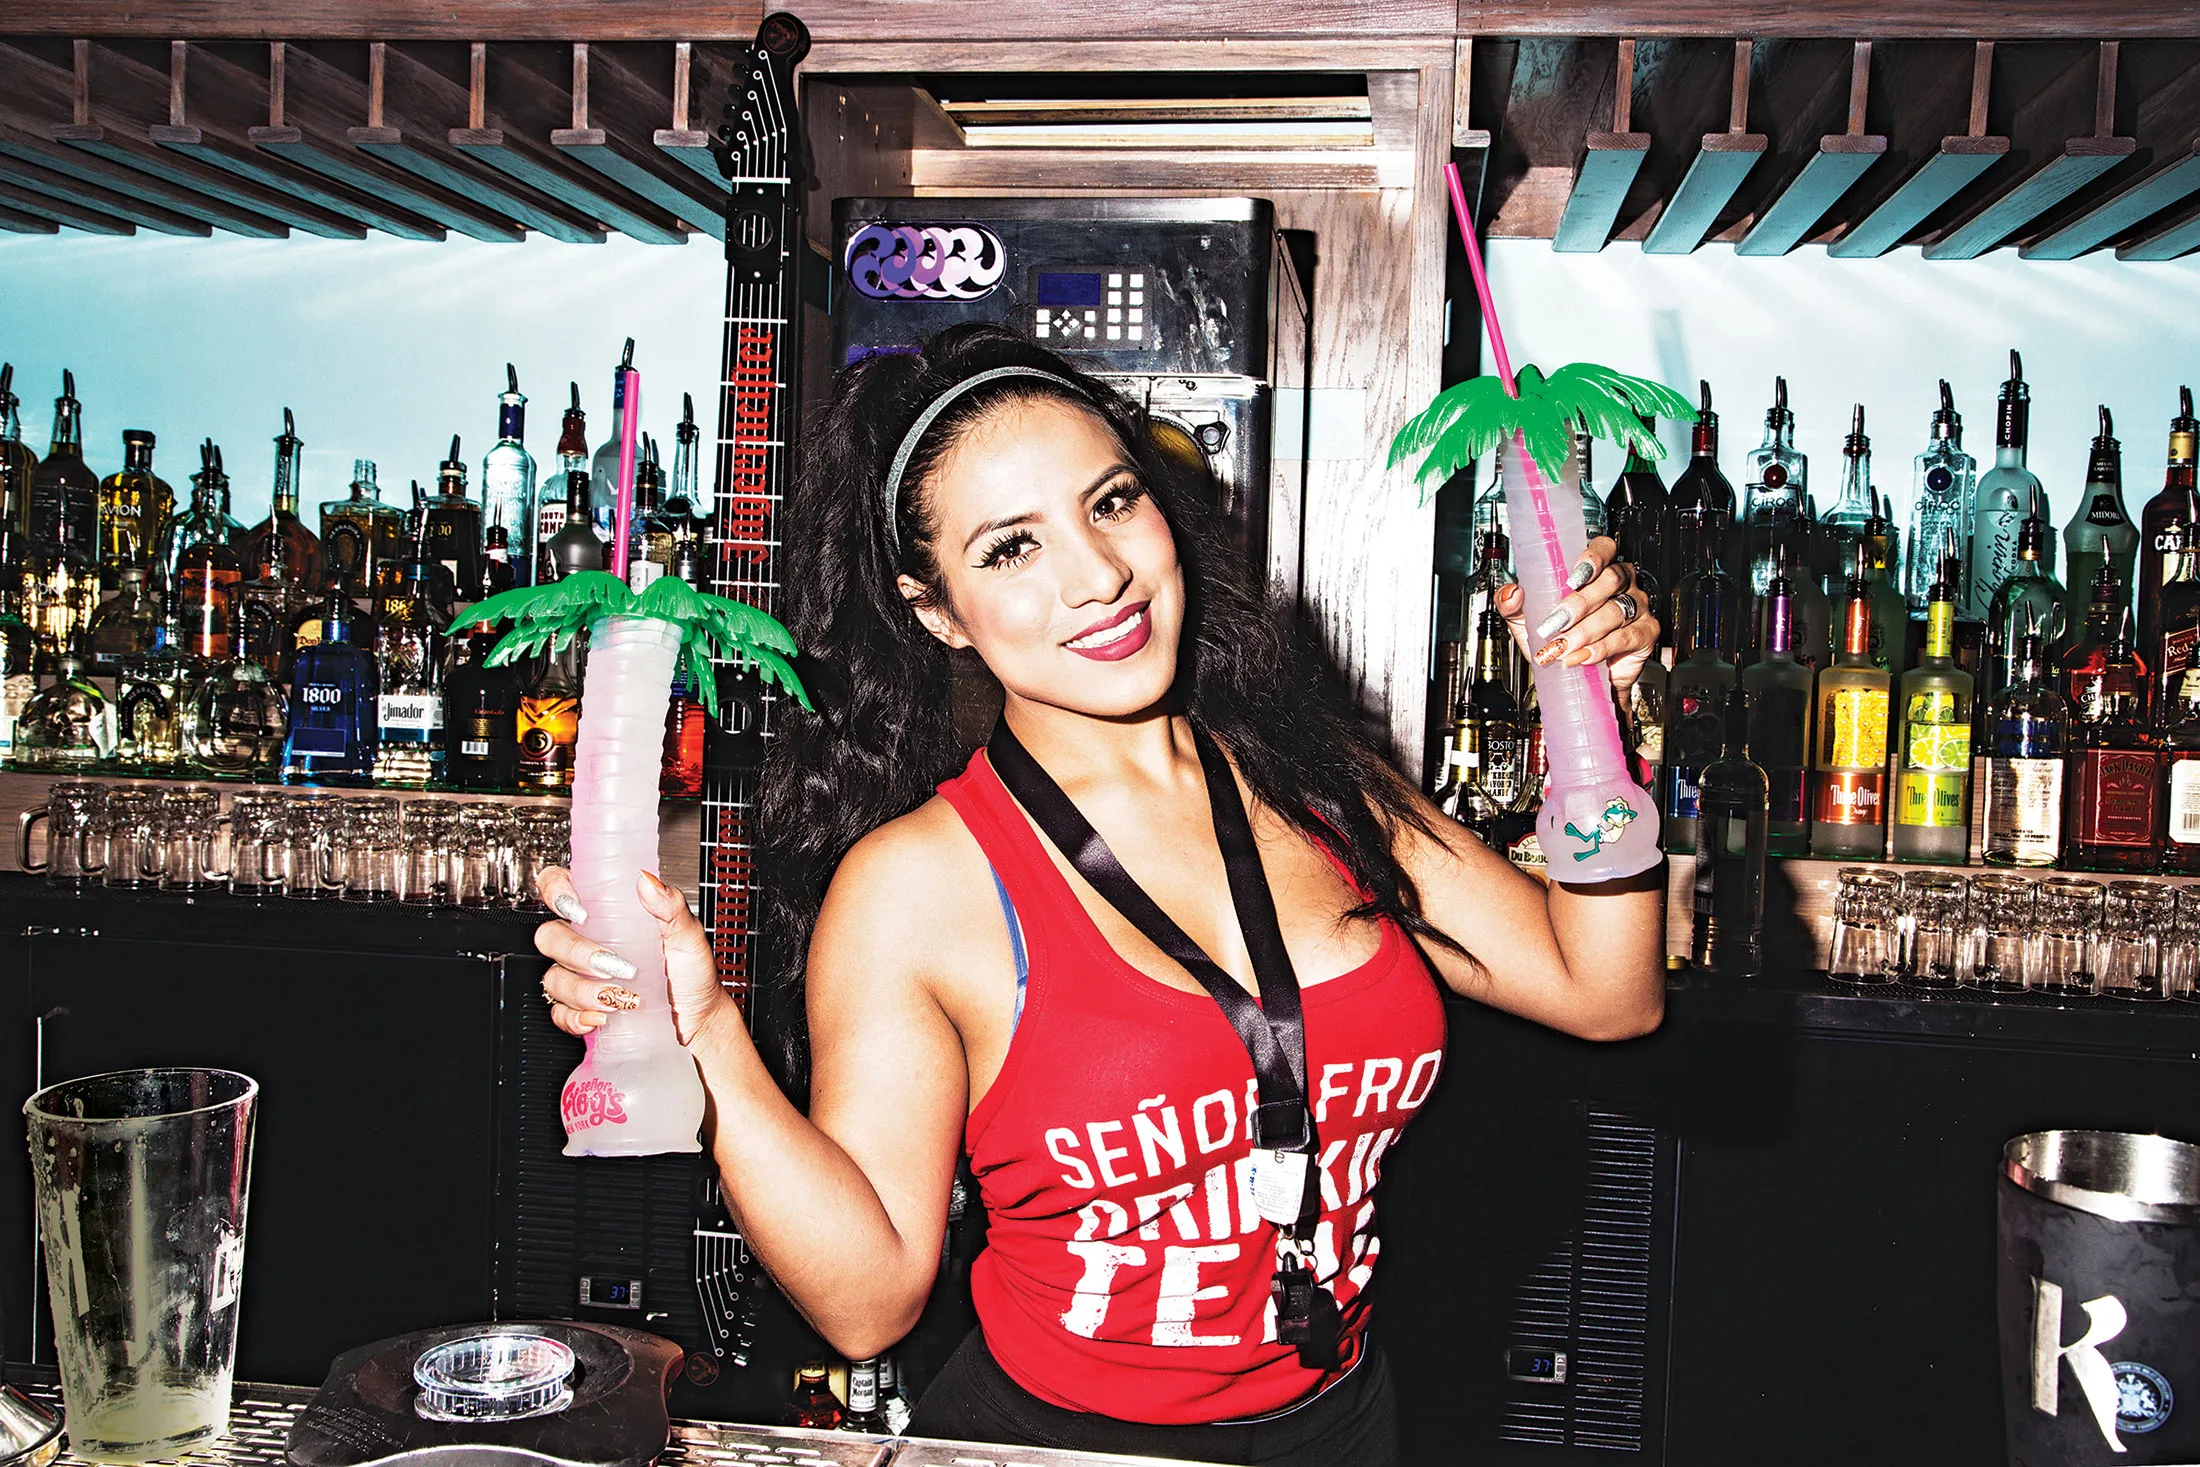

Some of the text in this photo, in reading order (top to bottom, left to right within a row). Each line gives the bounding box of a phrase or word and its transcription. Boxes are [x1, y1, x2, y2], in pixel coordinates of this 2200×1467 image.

[2004, 403, 2013, 440] CHOPIN
[2091, 510, 2120, 520] MIDORI
[1974, 528, 2011, 612] Chopin
[2167, 644, 2190, 657] Red
[127, 686, 164, 708] HERRADURA
[302, 687, 342, 704] 1800
[383, 702, 425, 721] Jimador
[1857, 786, 1881, 807] Olives
[580, 1077, 613, 1094] señor
[561, 1080, 628, 1126] Frog's
[574, 1119, 590, 1133] YORK
[610, 1285, 626, 1299] 37
[1531, 1358, 1550, 1373] 37
[852, 1377, 874, 1387] Captain
[852, 1387, 874, 1398] Morgan
